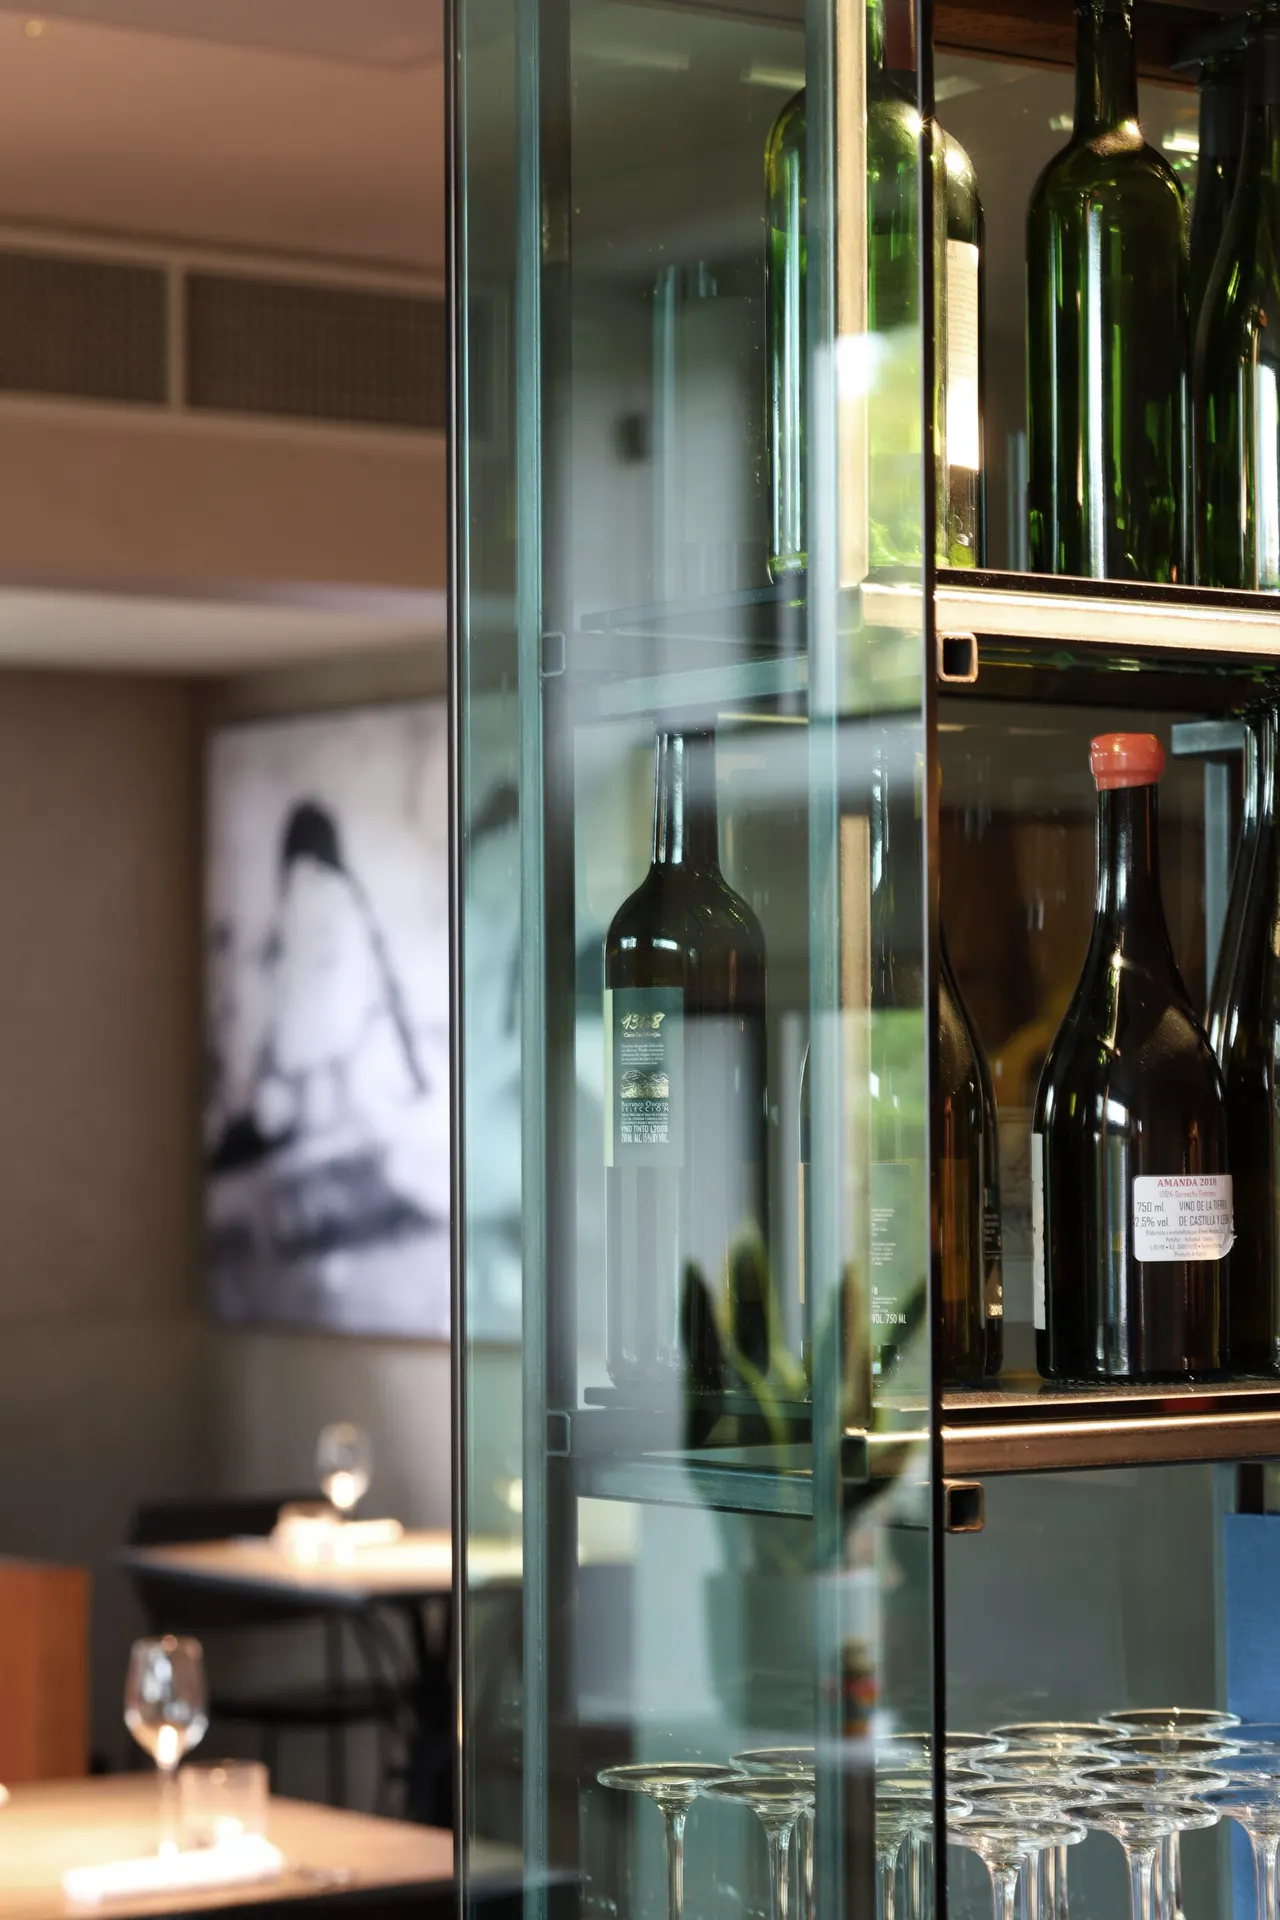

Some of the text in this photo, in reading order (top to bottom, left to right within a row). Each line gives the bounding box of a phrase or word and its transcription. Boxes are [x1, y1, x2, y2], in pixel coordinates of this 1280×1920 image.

[1157, 1177, 1217, 1188] AMANDA 2018
[1137, 1201, 1152, 1213] 750
[1178, 1200, 1195, 1211] VINO
[1197, 1200, 1204, 1211] DE
[1205, 1200, 1213, 1211] LA
[1178, 1215, 1187, 1226] DE
[1189, 1214, 1215, 1226] CASTILLA
[886, 1313, 897, 1324] 750
